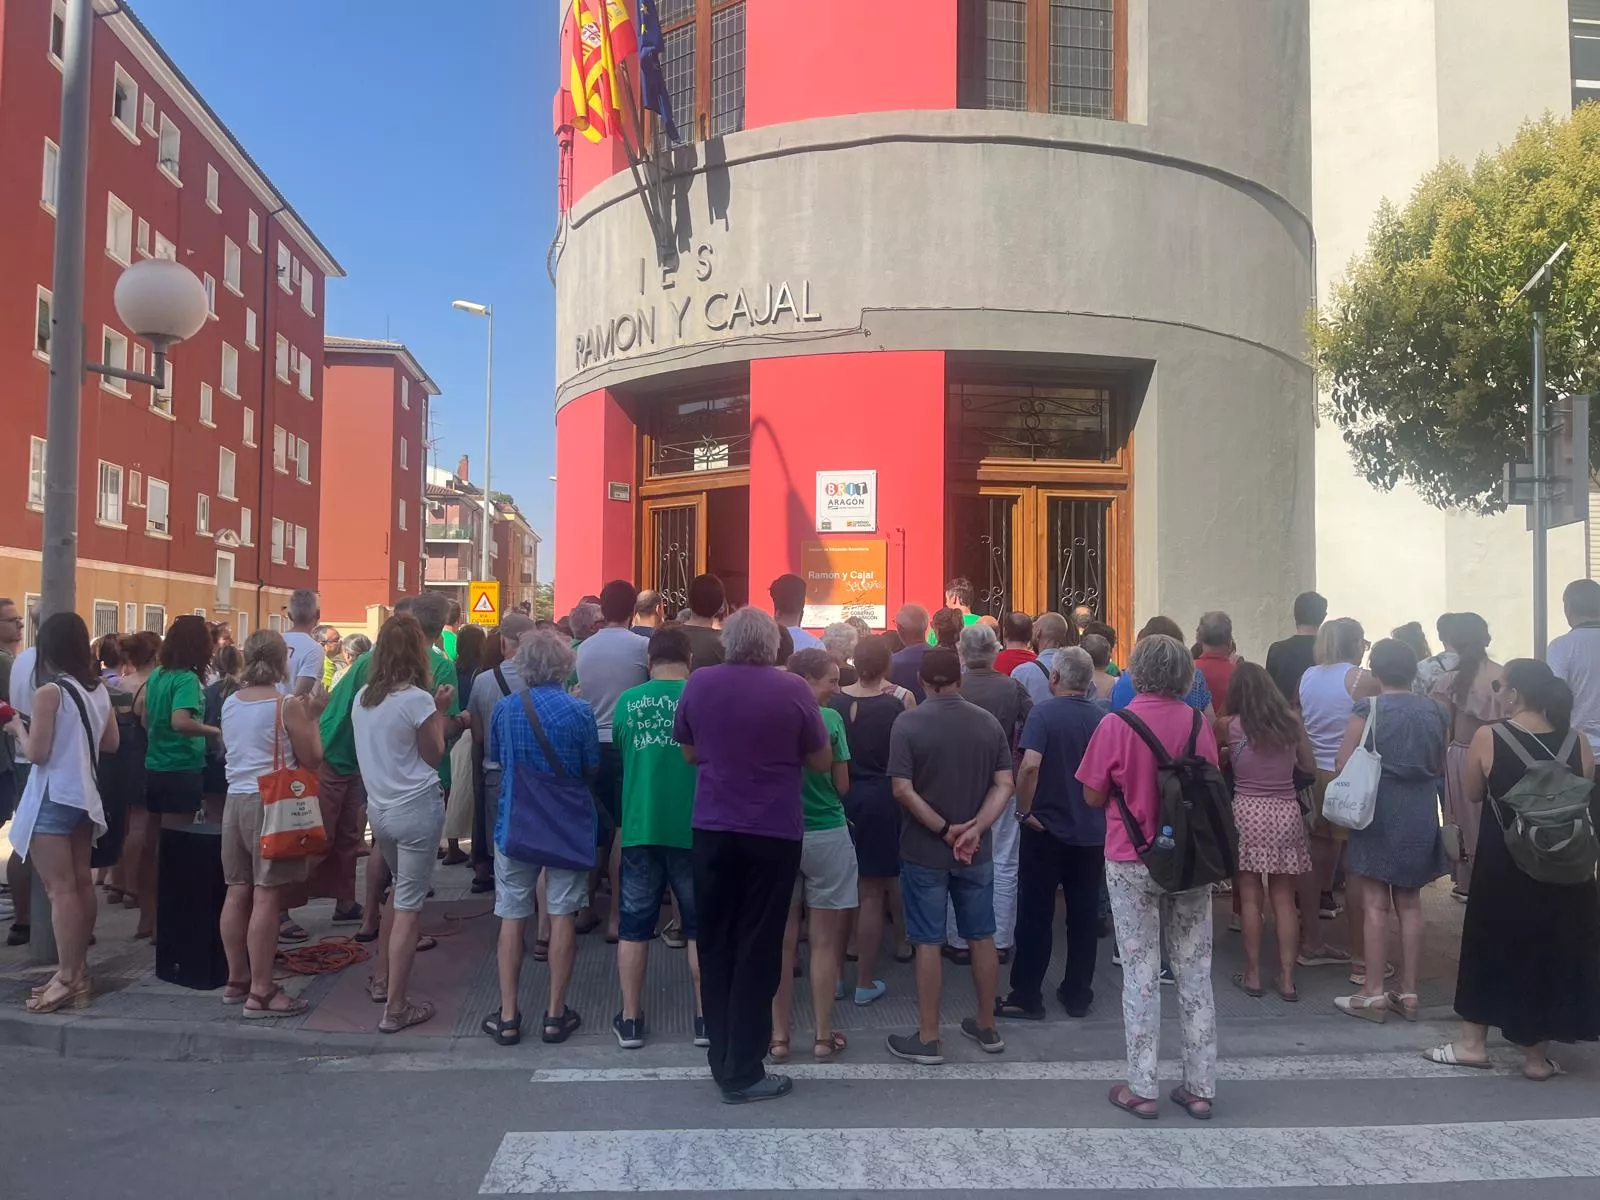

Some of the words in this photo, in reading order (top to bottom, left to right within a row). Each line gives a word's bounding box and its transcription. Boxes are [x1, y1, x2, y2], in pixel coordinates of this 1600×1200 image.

[575, 305, 656, 371] RAMON
[670, 296, 692, 338] Y
[704, 280, 822, 332] CAJAL
[808, 570, 840, 579] Ramón
[842, 572, 848, 581] y
[627, 696, 665, 713] ESCUELA
[637, 719, 651, 730] DE
